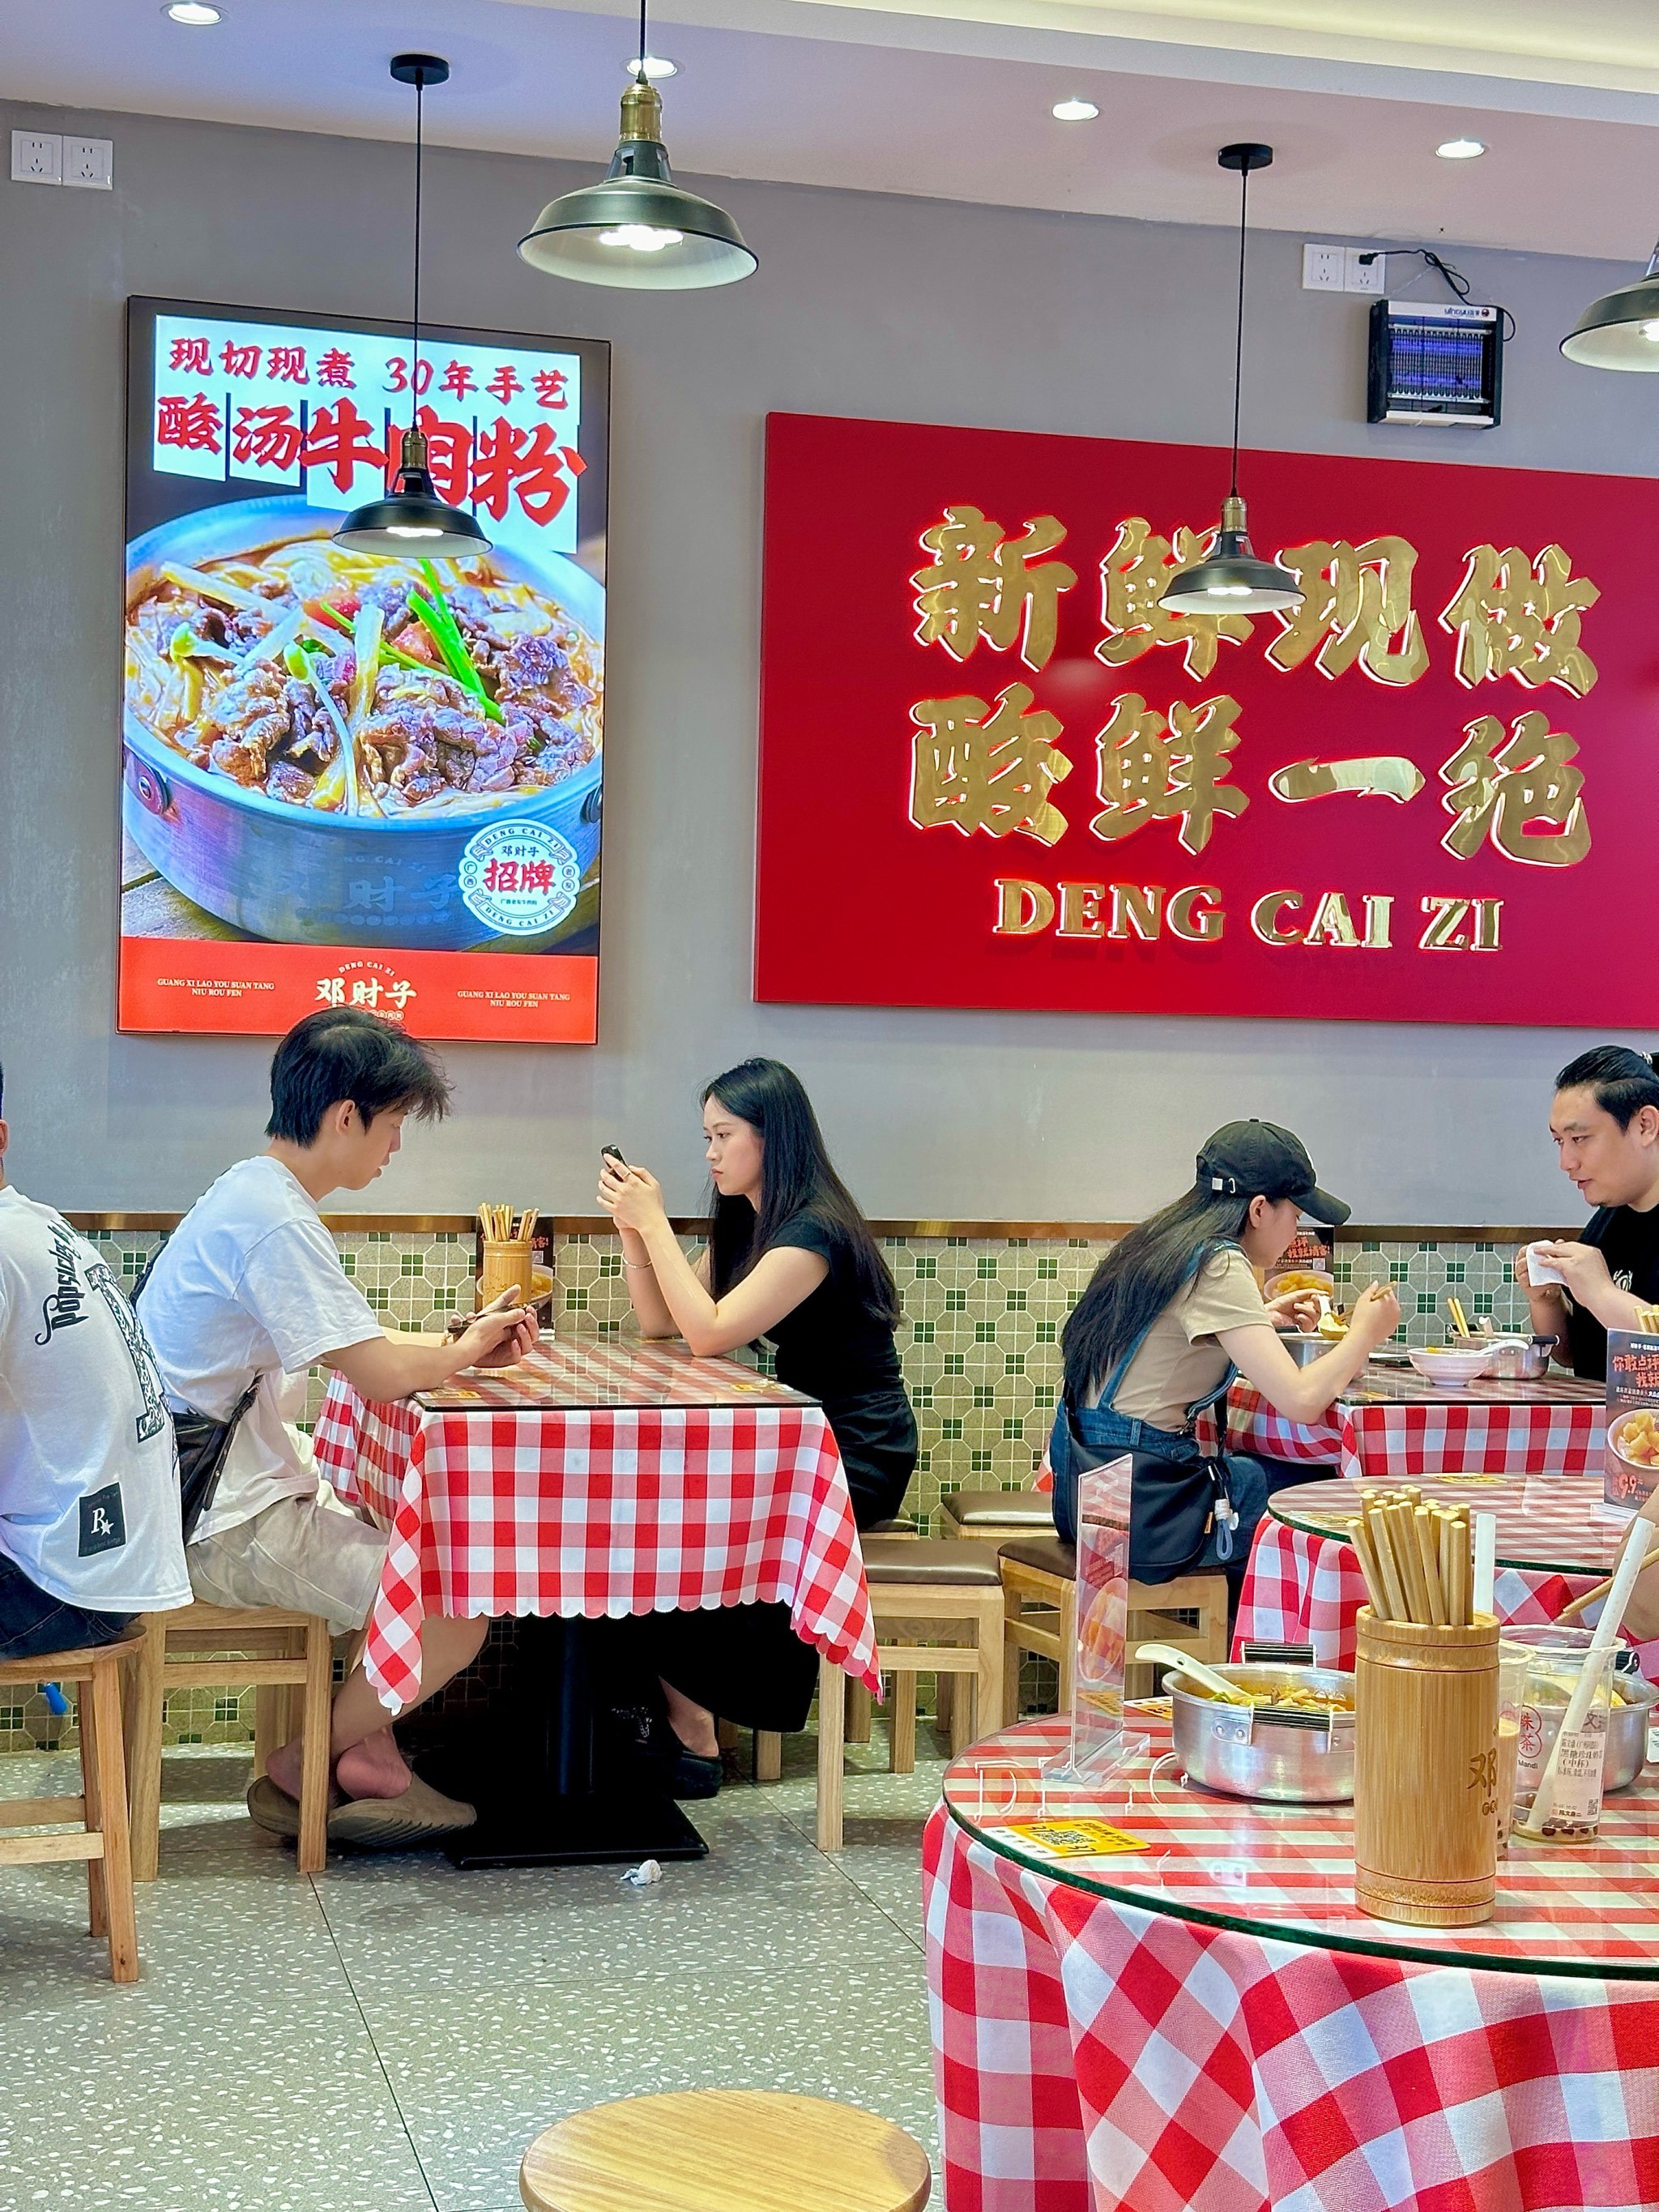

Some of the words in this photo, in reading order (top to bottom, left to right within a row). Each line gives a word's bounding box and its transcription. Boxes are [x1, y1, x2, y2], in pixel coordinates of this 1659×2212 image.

[168, 336, 356, 390] 现切现煮
[382, 357, 569, 410] 30年手艺
[909, 505, 1601, 700] 新鲜现做
[907, 681, 1593, 869] 酸鲜一绝
[485, 827, 514, 845] DENG
[522, 827, 544, 838] CAI
[548, 837, 559, 850] ZI
[501, 845, 540, 857] 邓财子
[483, 857, 557, 896] 招牌
[485, 907, 513, 925] DENG
[518, 918, 538, 927] CAI
[544, 909, 554, 920] ZI
[992, 878, 1226, 941] DENG
[1251, 890, 1395, 948] CAI
[1419, 897, 1505, 952] ZI
[337, 960, 365, 974] DENG
[366, 961, 385, 971] CAI
[384, 967, 396, 977] ZI
[157, 978, 186, 986] GUANG
[186, 979, 195, 987] XI
[197, 980, 212, 988] LAO
[214, 980, 229, 989] YOU
[231, 981, 253, 989] SUAN
[254, 982, 275, 990] TANG
[192, 988, 207, 996] NIU
[208, 989, 225, 997] ROU
[314, 976, 418, 1010] 邓财子
[457, 990, 484, 998] GUANG
[495, 991, 510, 999] LAO
[511, 992, 527, 1000] YOU
[528, 993, 548, 1001] SUAN
[490, 999, 504, 1007] NIU
[91, 1507, 106, 1535] R
